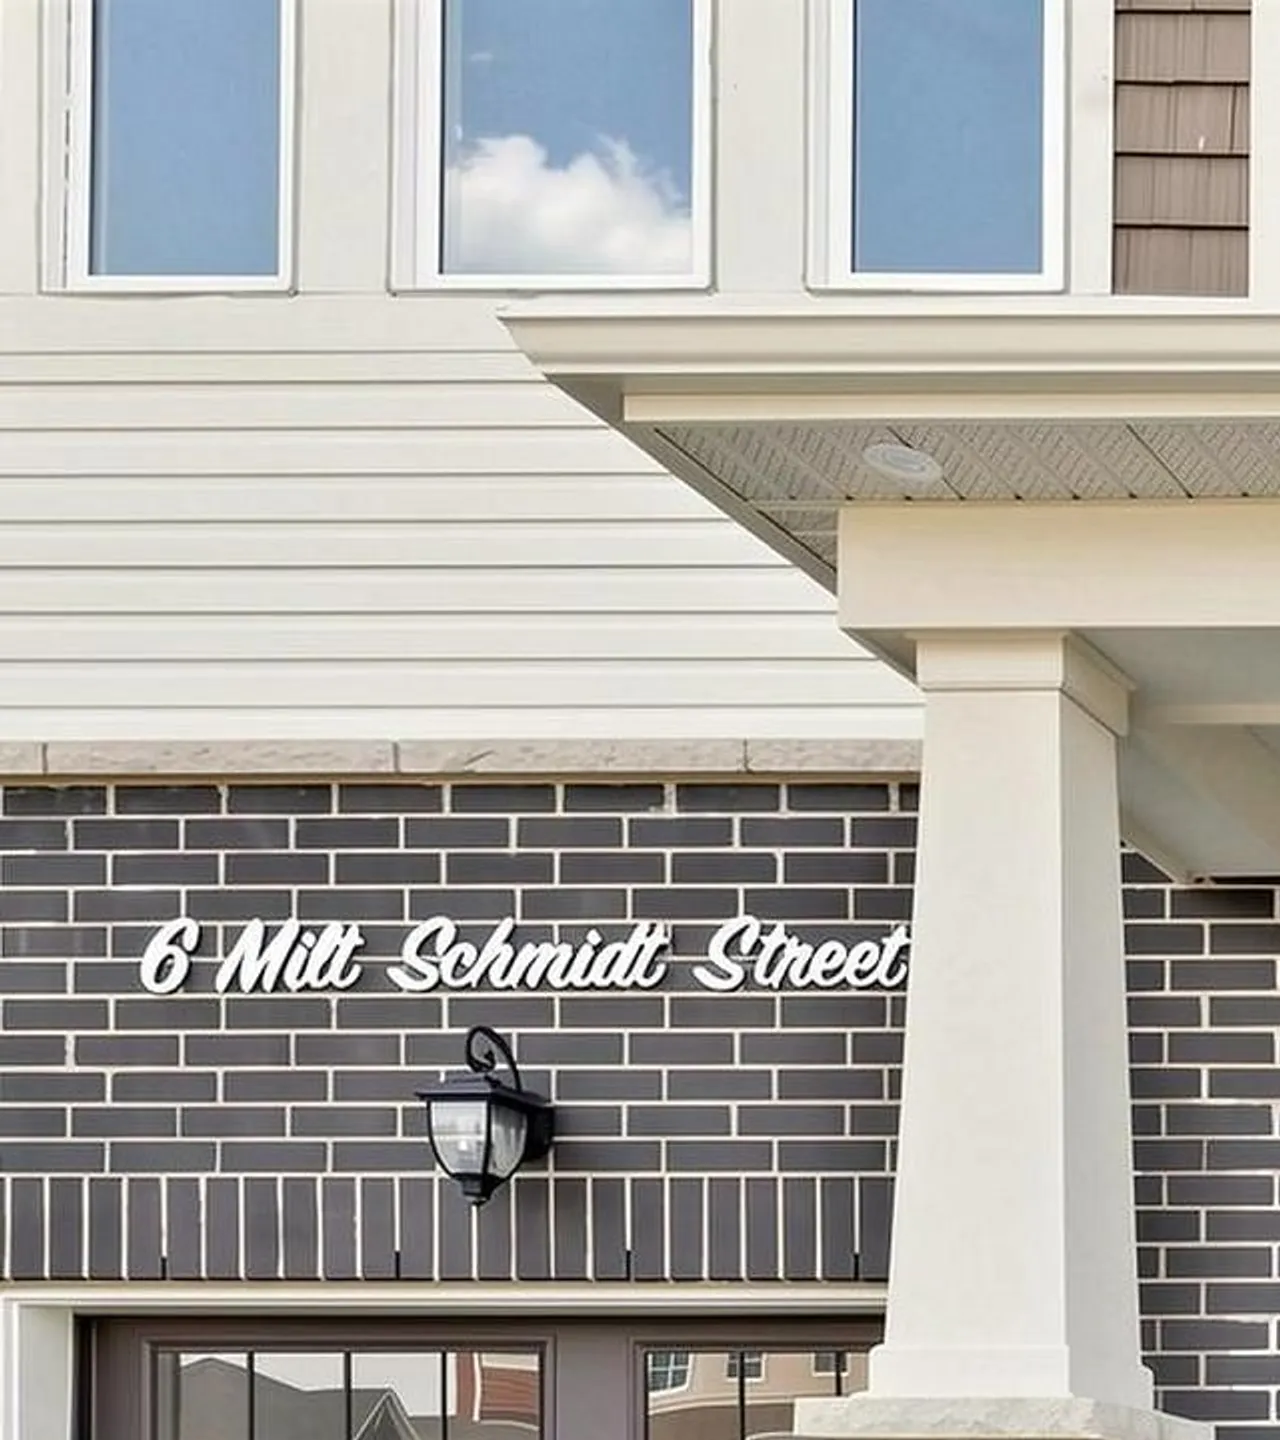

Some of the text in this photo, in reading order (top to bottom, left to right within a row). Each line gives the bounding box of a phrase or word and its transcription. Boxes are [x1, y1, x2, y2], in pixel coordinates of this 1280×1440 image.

[140, 915, 912, 994] 6 Milt Schmidt Street
